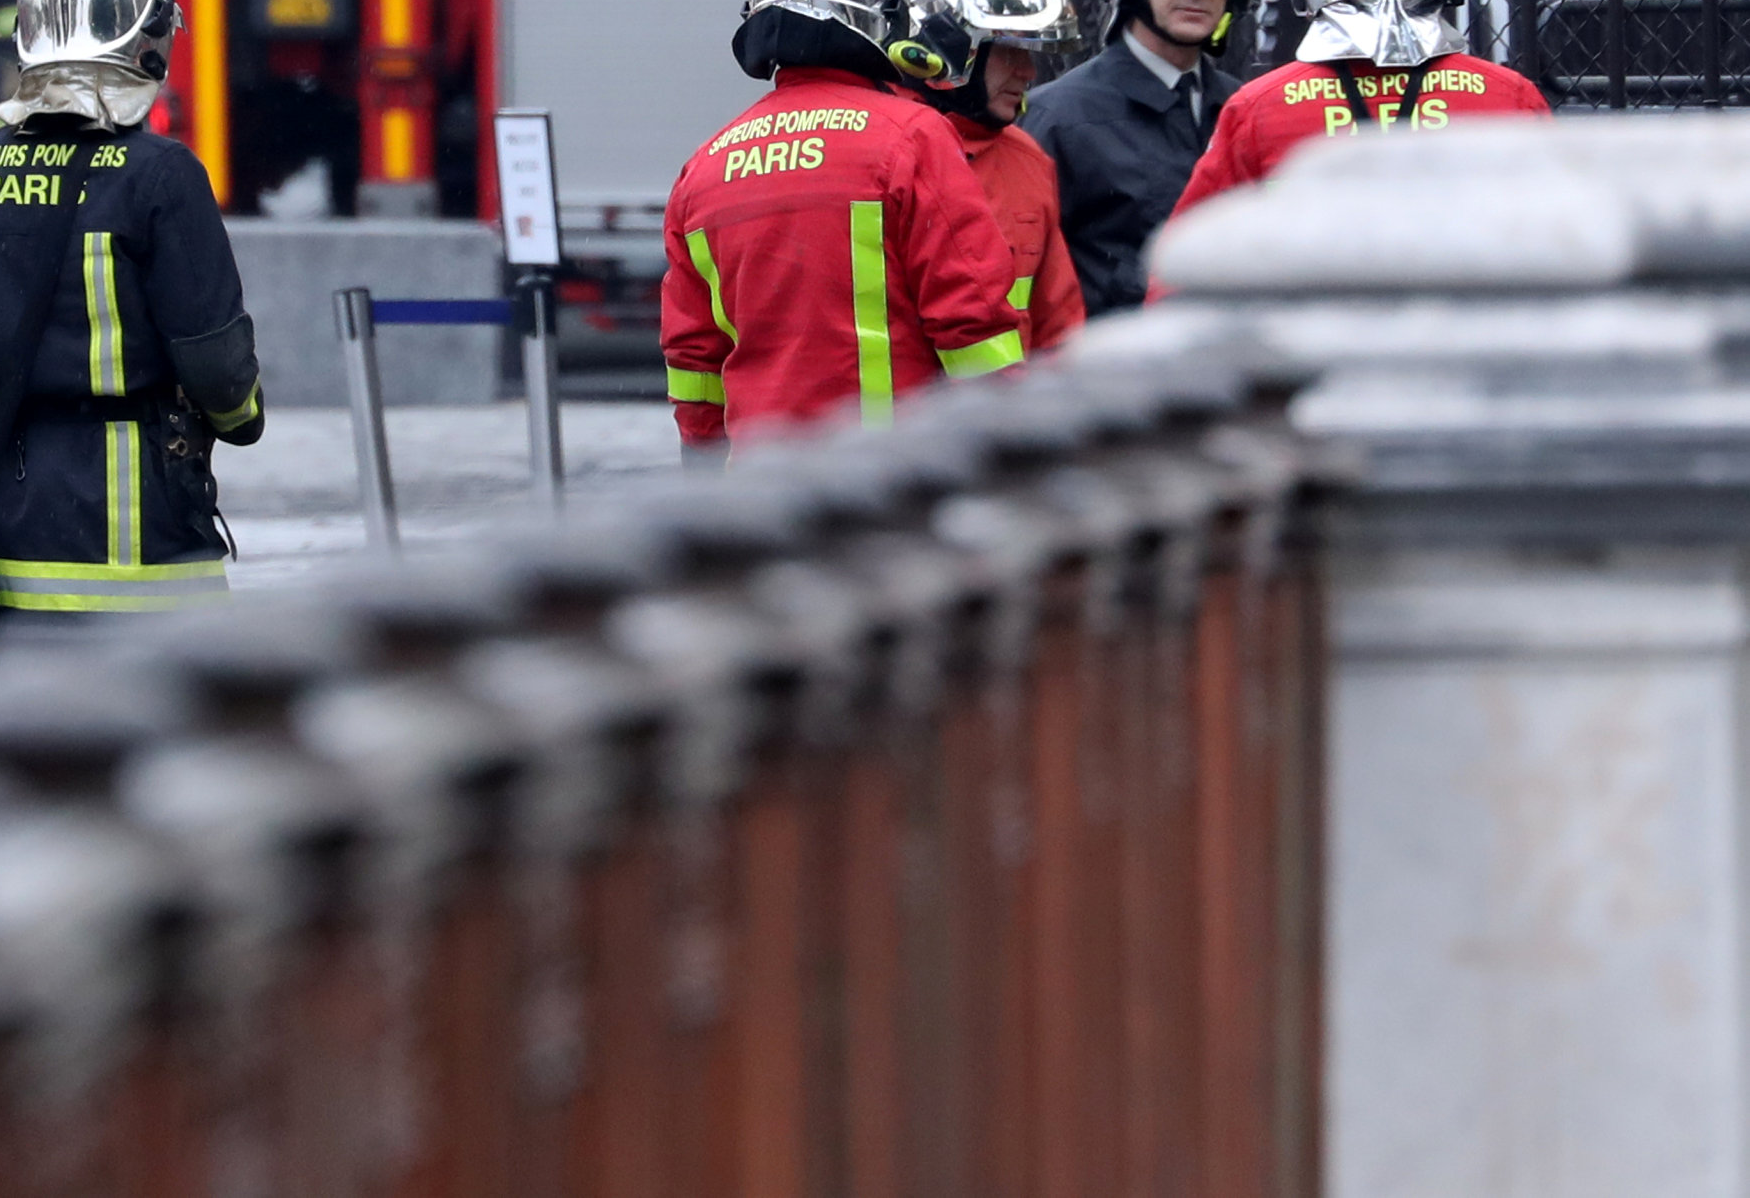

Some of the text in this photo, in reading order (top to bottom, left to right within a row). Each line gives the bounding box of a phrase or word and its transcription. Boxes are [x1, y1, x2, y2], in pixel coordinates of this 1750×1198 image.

[1284, 69, 1486, 105] SAPEURS POPIERS
[708, 108, 869, 156] SAPEURS POMPIERS
[1324, 99, 1449, 137] PRIS
[31, 143, 128, 168] POMERS
[724, 137, 825, 182] PARIS
